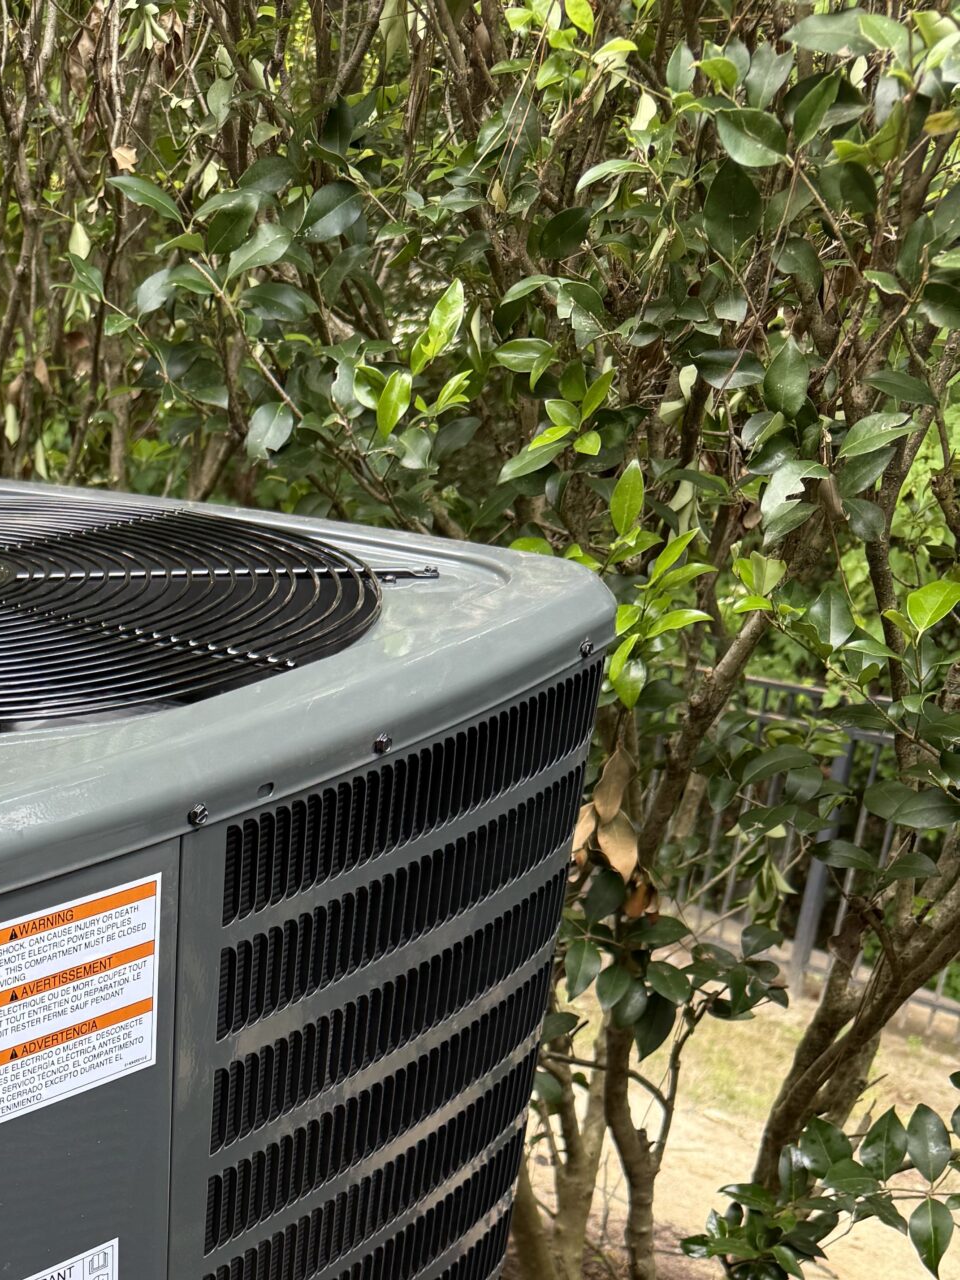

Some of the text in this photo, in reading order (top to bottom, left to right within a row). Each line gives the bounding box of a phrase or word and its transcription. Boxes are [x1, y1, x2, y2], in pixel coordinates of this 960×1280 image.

[19, 910, 74, 937] WARNING
[28, 934, 45, 948] CAN
[46, 926, 72, 942] CAUSE
[74, 917, 100, 933] INJURY
[102, 914, 113, 923] OR
[114, 905, 139, 920] DEATH
[28, 939, 66, 958] ELECTRIC
[67, 929, 95, 946] POWER
[96, 918, 132, 936] SUPPLIES
[5, 964, 23, 976] THIS
[24, 946, 82, 969] COMPARTMENT
[84, 936, 104, 951] MUST
[106, 933, 116, 943] BE
[118, 923, 146, 940] CLOSED
[21, 958, 112, 998] AVERTISSEMENT
[21, 1020, 98, 1055] ADVERTENCIA
[6, 1084, 43, 1104] CERRADO
[45, 1070, 79, 1088] EXCEPTO
[80, 1058, 113, 1074] DURANTE
[115, 1054, 123, 1062] EL
